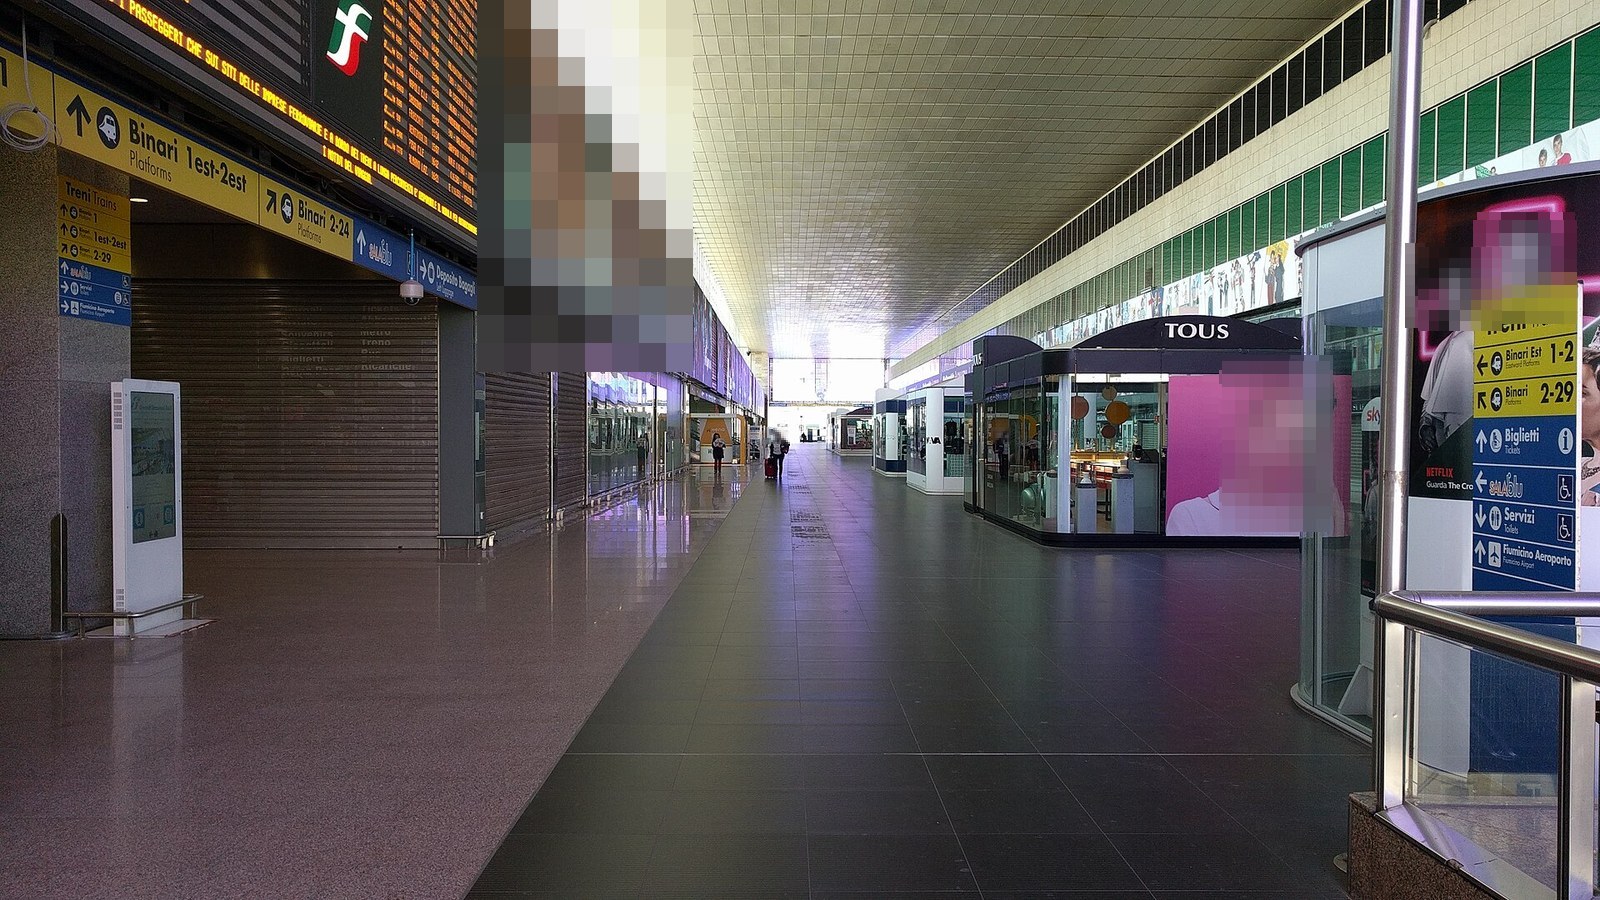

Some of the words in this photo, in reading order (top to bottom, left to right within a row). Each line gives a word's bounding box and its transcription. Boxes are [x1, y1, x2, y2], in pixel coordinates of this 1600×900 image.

[130, 0, 184, 47] PASSEGGERI
[186, 37, 202, 59] CHE
[205, 50, 219, 70] SUI
[221, 60, 237, 81] SITI
[240, 72, 260, 96] DELLE
[129, 118, 178, 162] Binari
[186, 146, 246, 192] 1est-2est
[130, 150, 172, 182] Platforms
[66, 182, 91, 202] Treni
[93, 190, 116, 211] Trains
[298, 199, 326, 228] Binari
[330, 214, 349, 238] 2-24
[94, 232, 126, 249] 1est-2est
[298, 222, 322, 244] Platforms
[94, 250, 111, 264] 2-29
[436, 264, 458, 287] Deposito
[458, 276, 476, 298] Bagagli
[1164, 323, 1229, 339] TOUS
[1506, 347, 1528, 361] Binari
[1530, 346, 1542, 358] Est
[1551, 340, 1574, 363] 1-2
[1506, 384, 1528, 397] Binari
[1540, 381, 1574, 403] 2-29
[1505, 427, 1540, 446] Biglietti
[1505, 445, 1520, 454] Tickets
[1426, 468, 1453, 478] NETFLIX
[1504, 507, 1534, 524] Servizi
[1504, 524, 1519, 534] Toilets
[1503, 544, 1533, 559] Fiumicino
[1535, 550, 1572, 567] Aeroporto
[1503, 556, 1520, 566] Fiumicino
[1521, 562, 1534, 570] Airport
